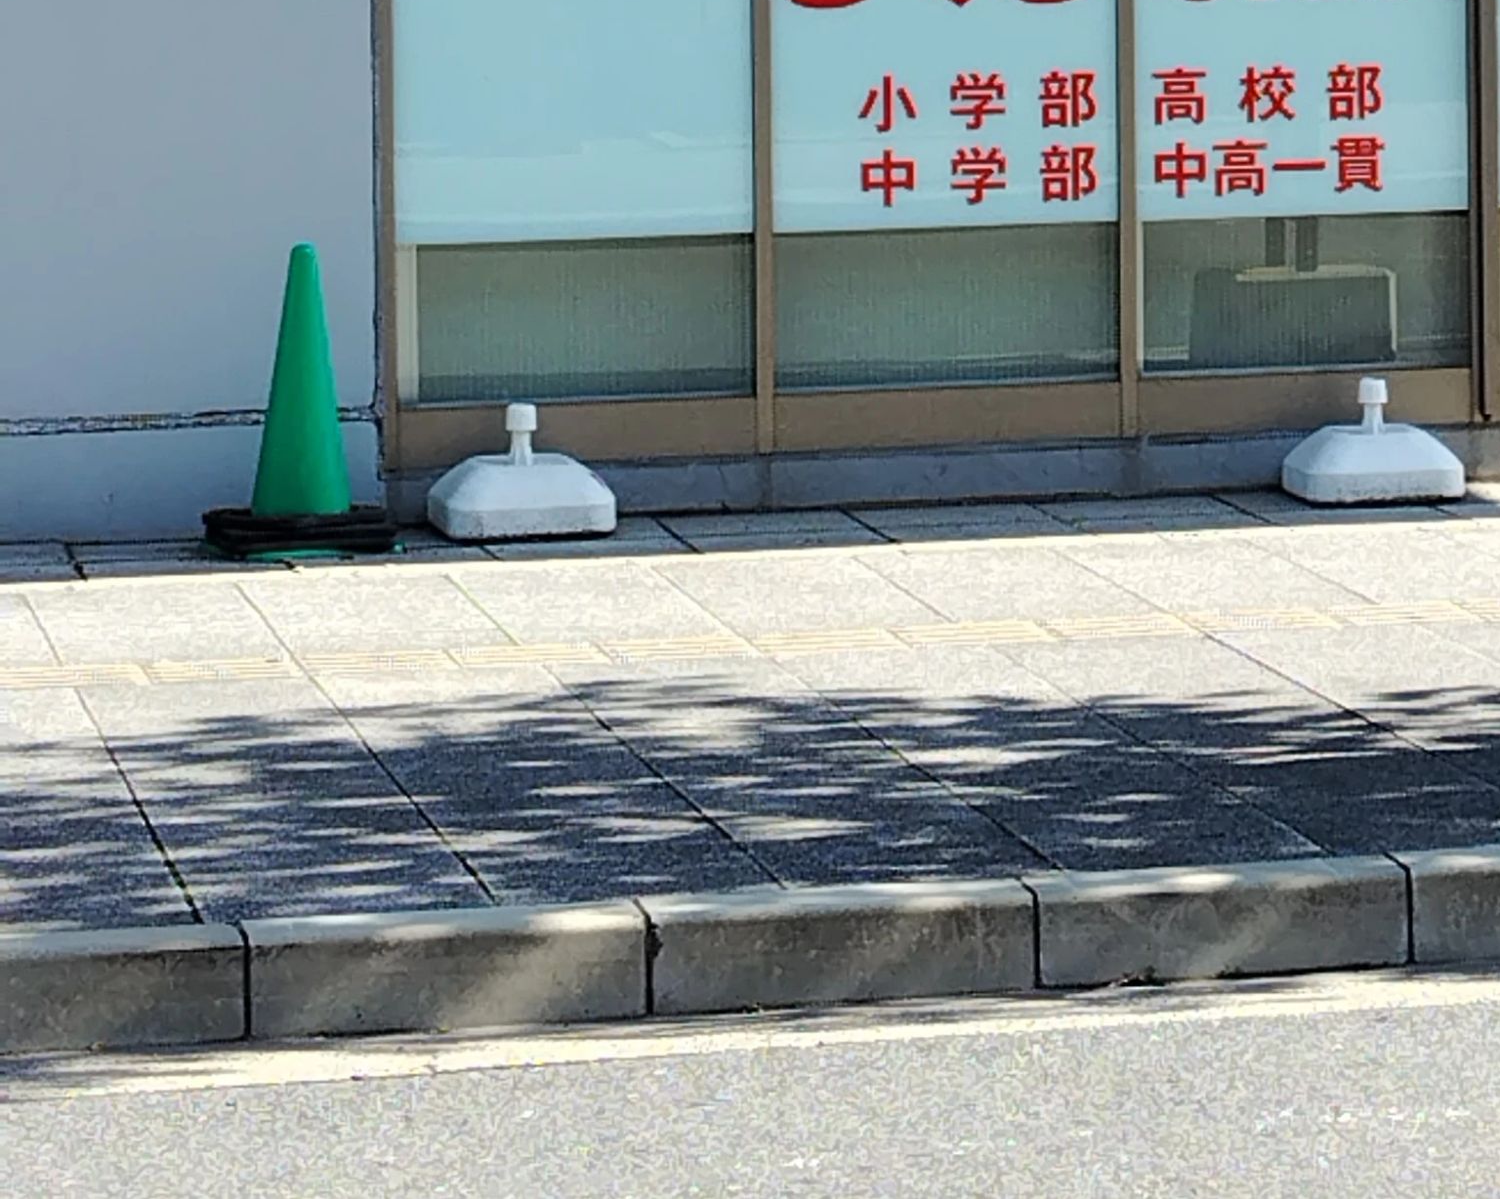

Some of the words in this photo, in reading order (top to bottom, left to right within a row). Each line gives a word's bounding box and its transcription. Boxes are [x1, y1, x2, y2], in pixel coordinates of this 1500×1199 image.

[863, 69, 1098, 130] 小学部
[1156, 62, 1384, 122] 高校部
[863, 143, 1099, 204] 中学部
[1155, 134, 1385, 194] 中高一貫
